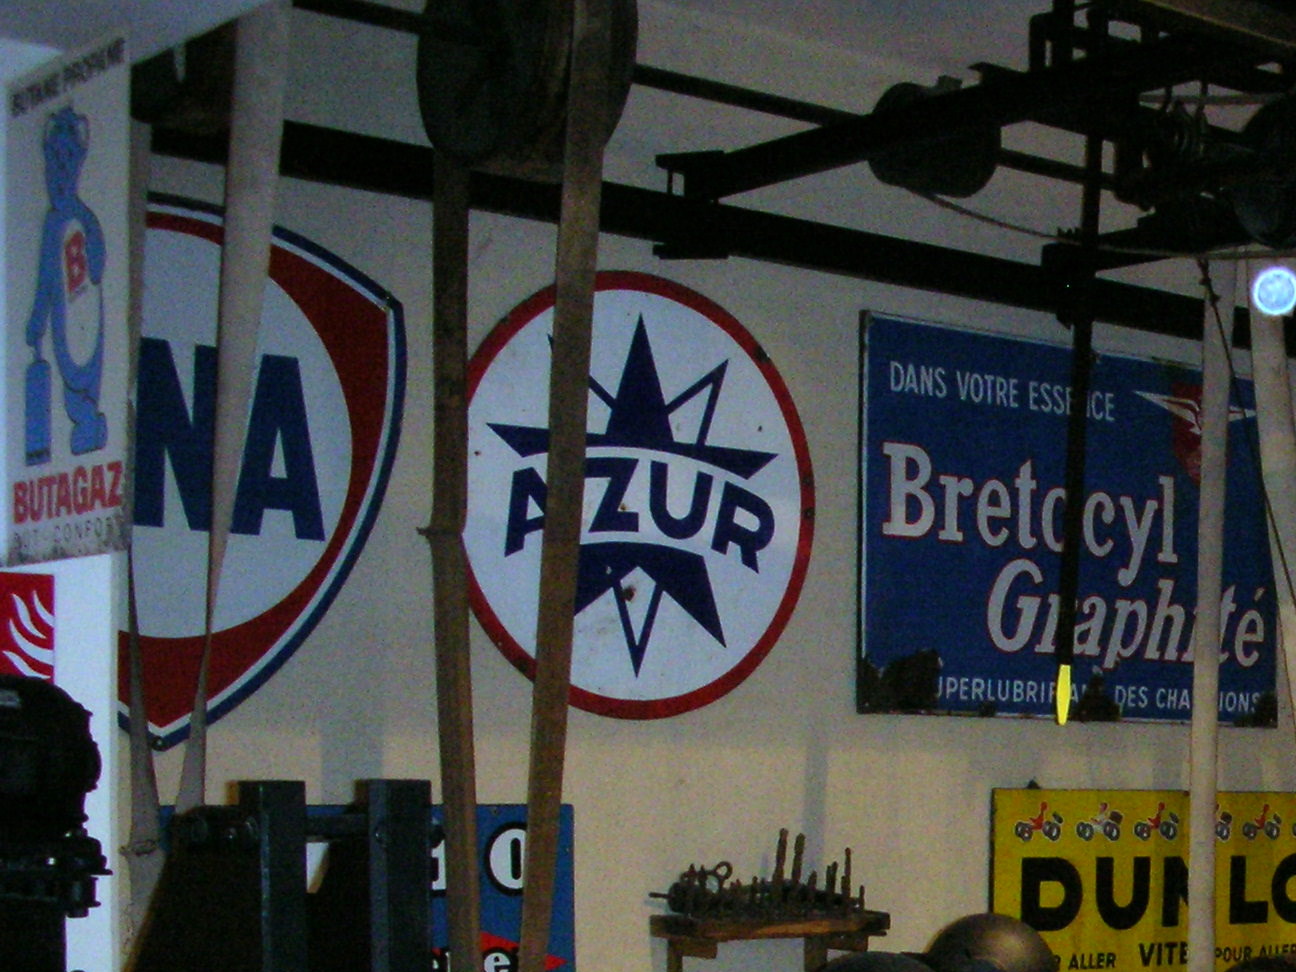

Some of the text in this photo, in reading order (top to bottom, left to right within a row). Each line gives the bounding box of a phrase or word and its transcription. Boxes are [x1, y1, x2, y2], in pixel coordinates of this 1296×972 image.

[890, 361, 1115, 421] DANS VOTRE ESSECE
[14, 461, 122, 524] BUTAGAZ
[504, 457, 775, 574] AZUR
[881, 441, 1179, 588] Bretocyl
[986, 557, 1267, 670] Graphté
[1114, 685, 1149, 709] DES
[1069, 953, 1116, 970] ALLER
